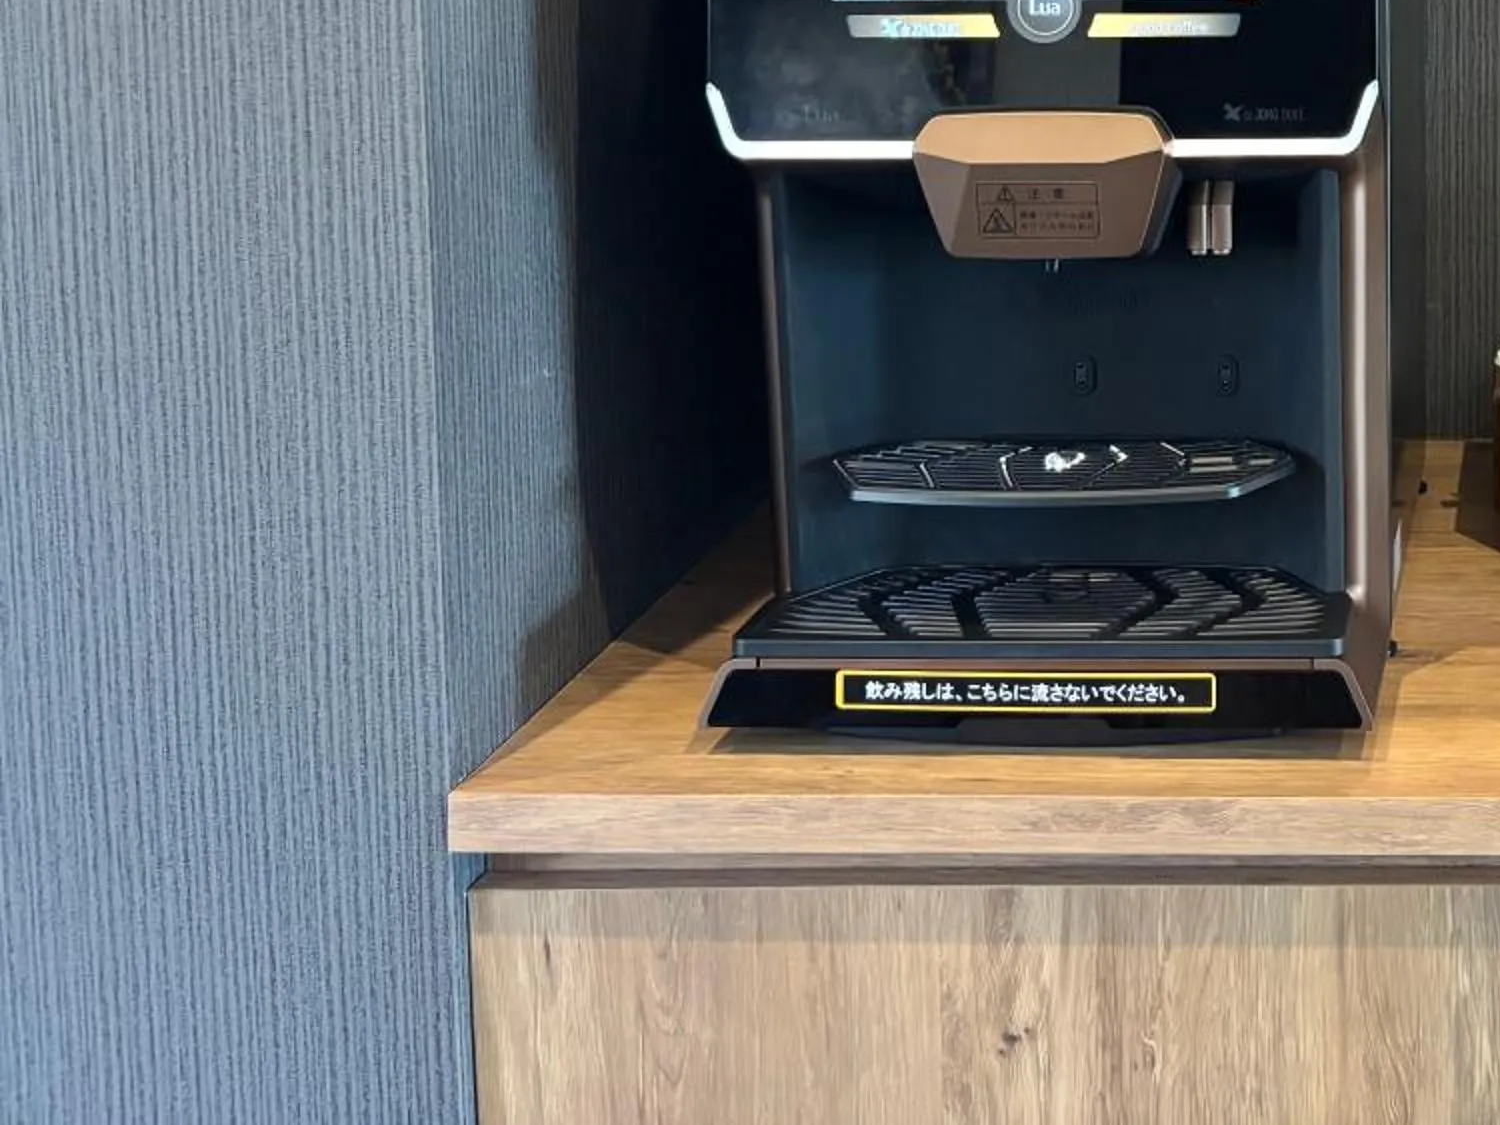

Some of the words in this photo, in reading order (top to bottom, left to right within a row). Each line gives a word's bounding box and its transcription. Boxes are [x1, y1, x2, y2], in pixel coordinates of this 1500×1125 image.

[865, 679, 1186, 703] 飲み残しは、こちらに流さないでください。
